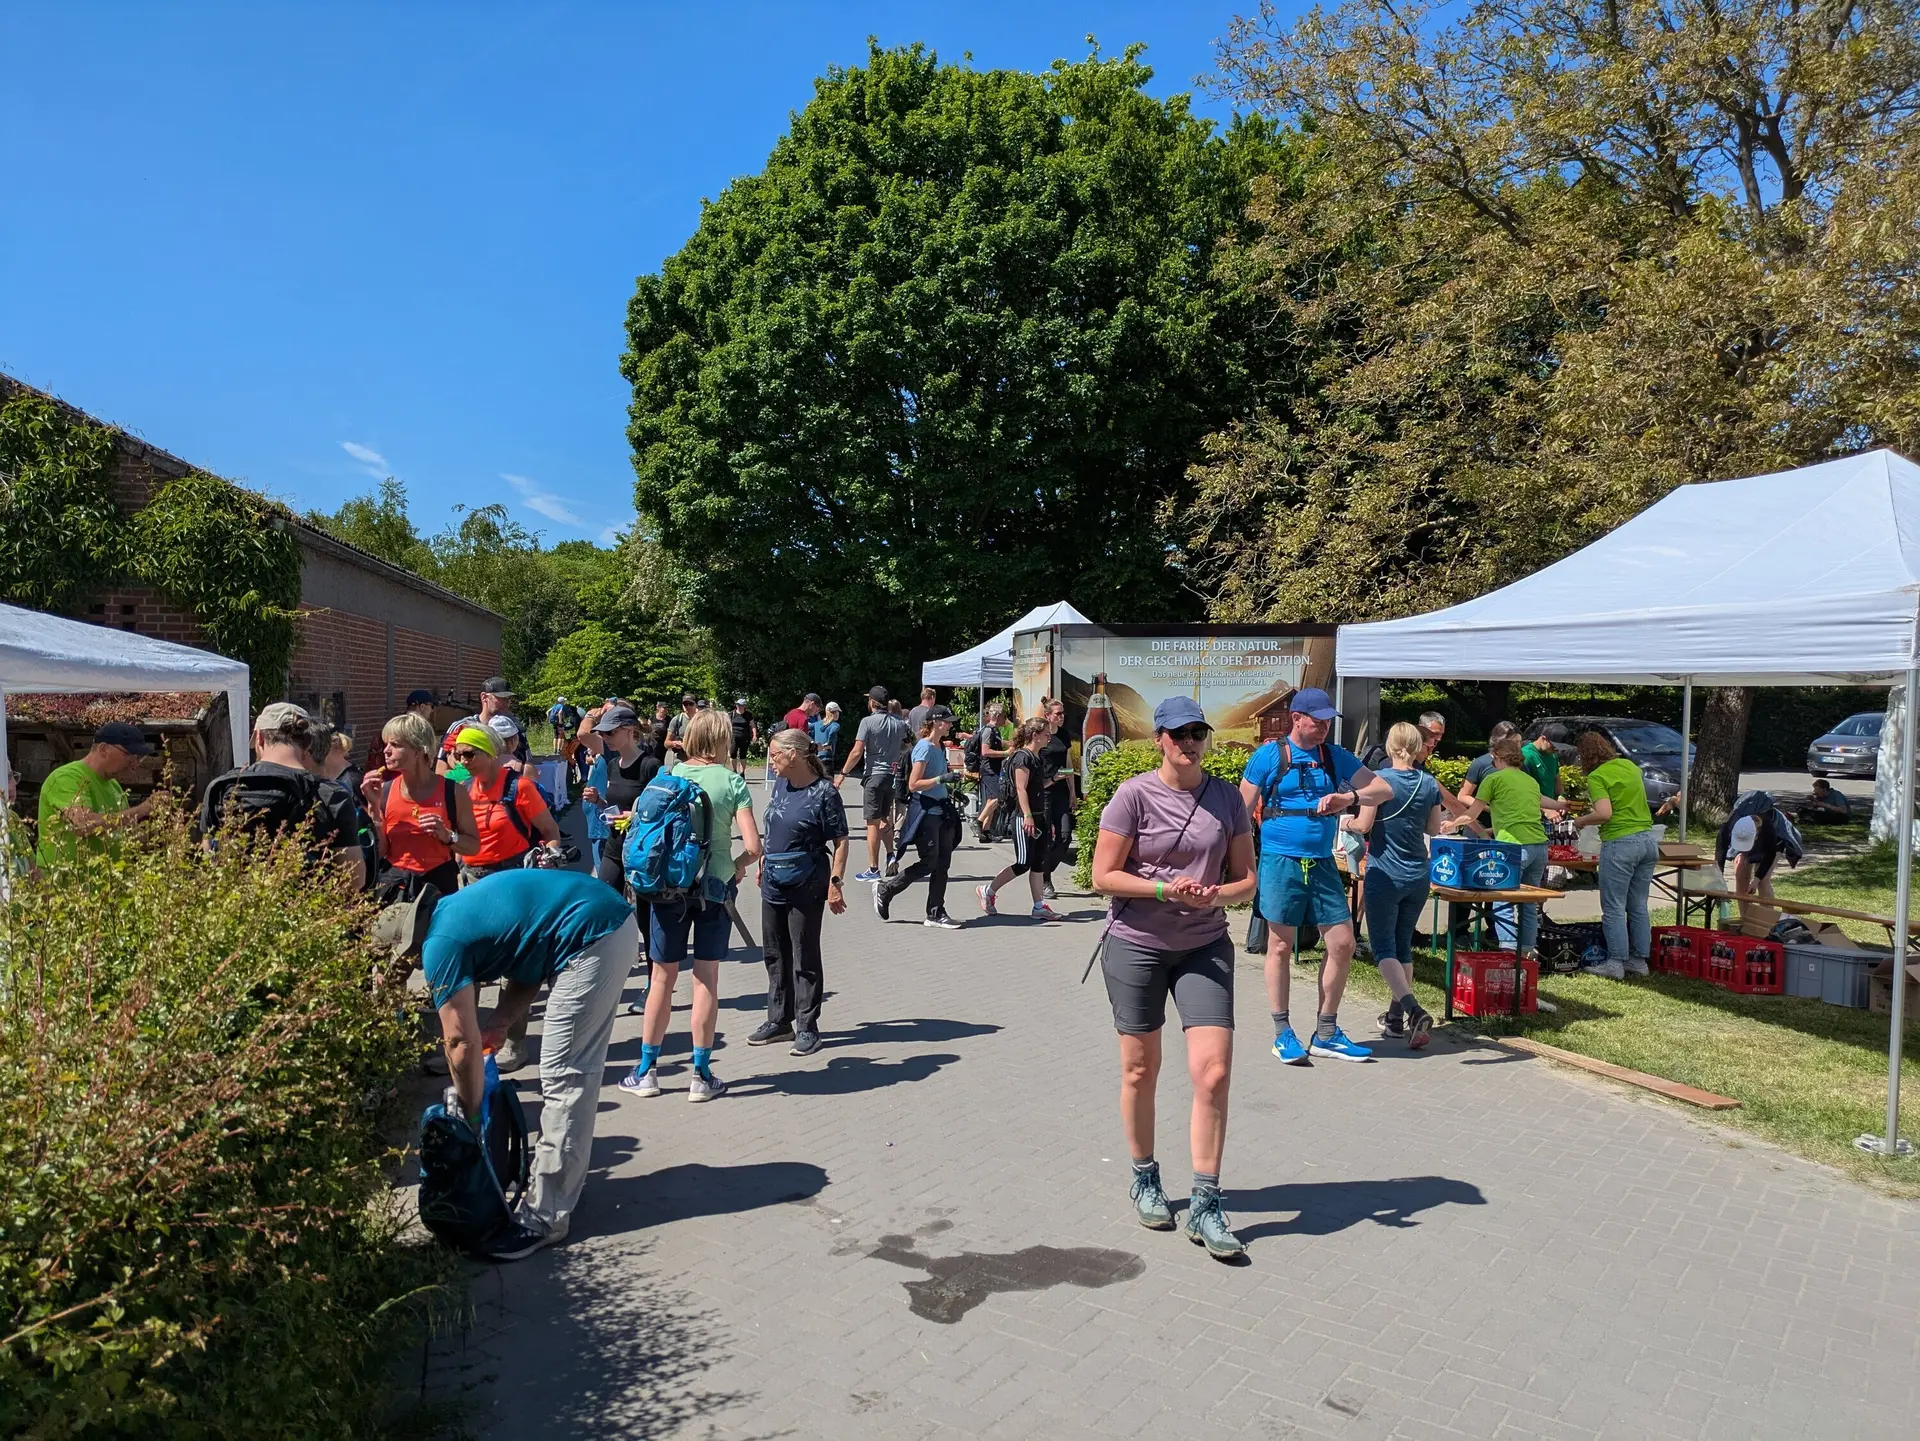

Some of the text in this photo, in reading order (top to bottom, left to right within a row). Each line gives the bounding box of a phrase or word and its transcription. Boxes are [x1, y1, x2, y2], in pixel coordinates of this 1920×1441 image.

[1151, 641, 1282, 651] DIE FARBE DER NATUR.
[1119, 655, 1313, 666] DER GESCHMACK DER TRADITION.
[1238, 670, 1275, 678] Kellerbier
[1211, 679, 1226, 687] und
